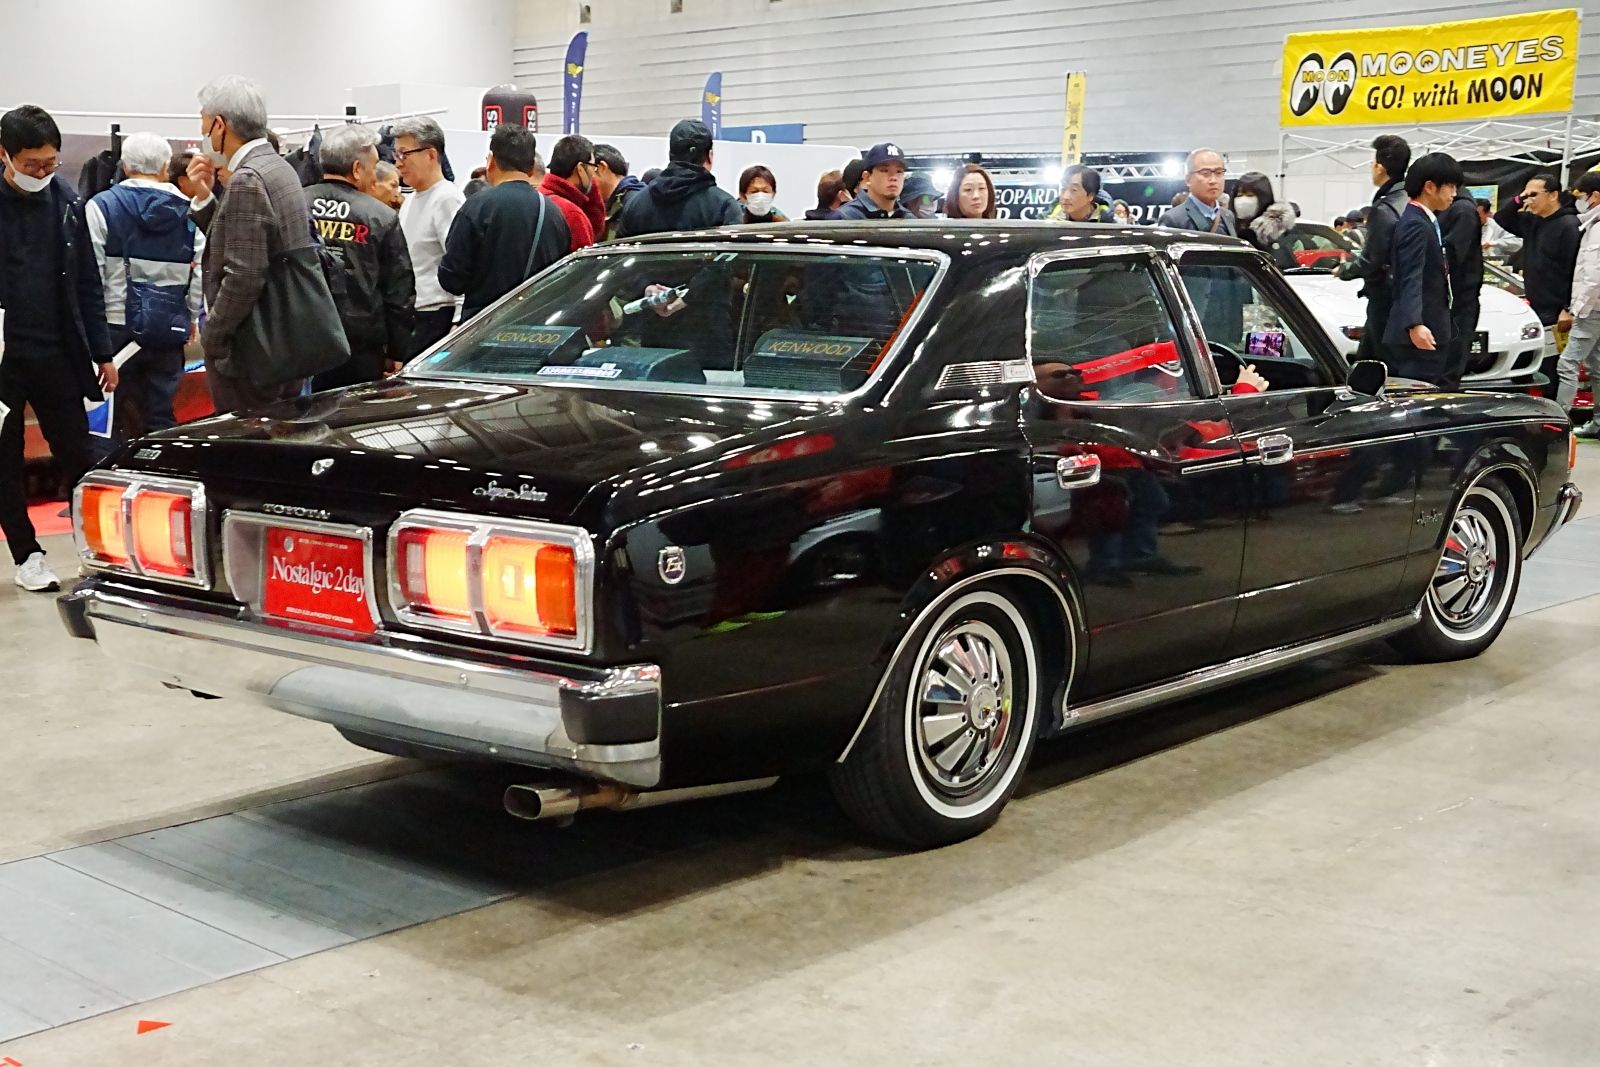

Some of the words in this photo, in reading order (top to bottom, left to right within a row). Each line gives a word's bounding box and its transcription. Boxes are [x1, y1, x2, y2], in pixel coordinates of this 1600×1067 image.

[1361, 36, 1564, 77] MOONEYES
[1302, 69, 1349, 83] MOON
[1367, 85, 1405, 110] GO!
[1413, 80, 1458, 107] with
[1466, 73, 1543, 104] MOON
[995, 188, 1058, 205] EOPARD
[312, 198, 350, 219] S20
[314, 219, 369, 244] WER
[494, 332, 561, 344] KENWOOD
[768, 341, 852, 355] KENWOOD
[271, 555, 334, 594] Nostalgic
